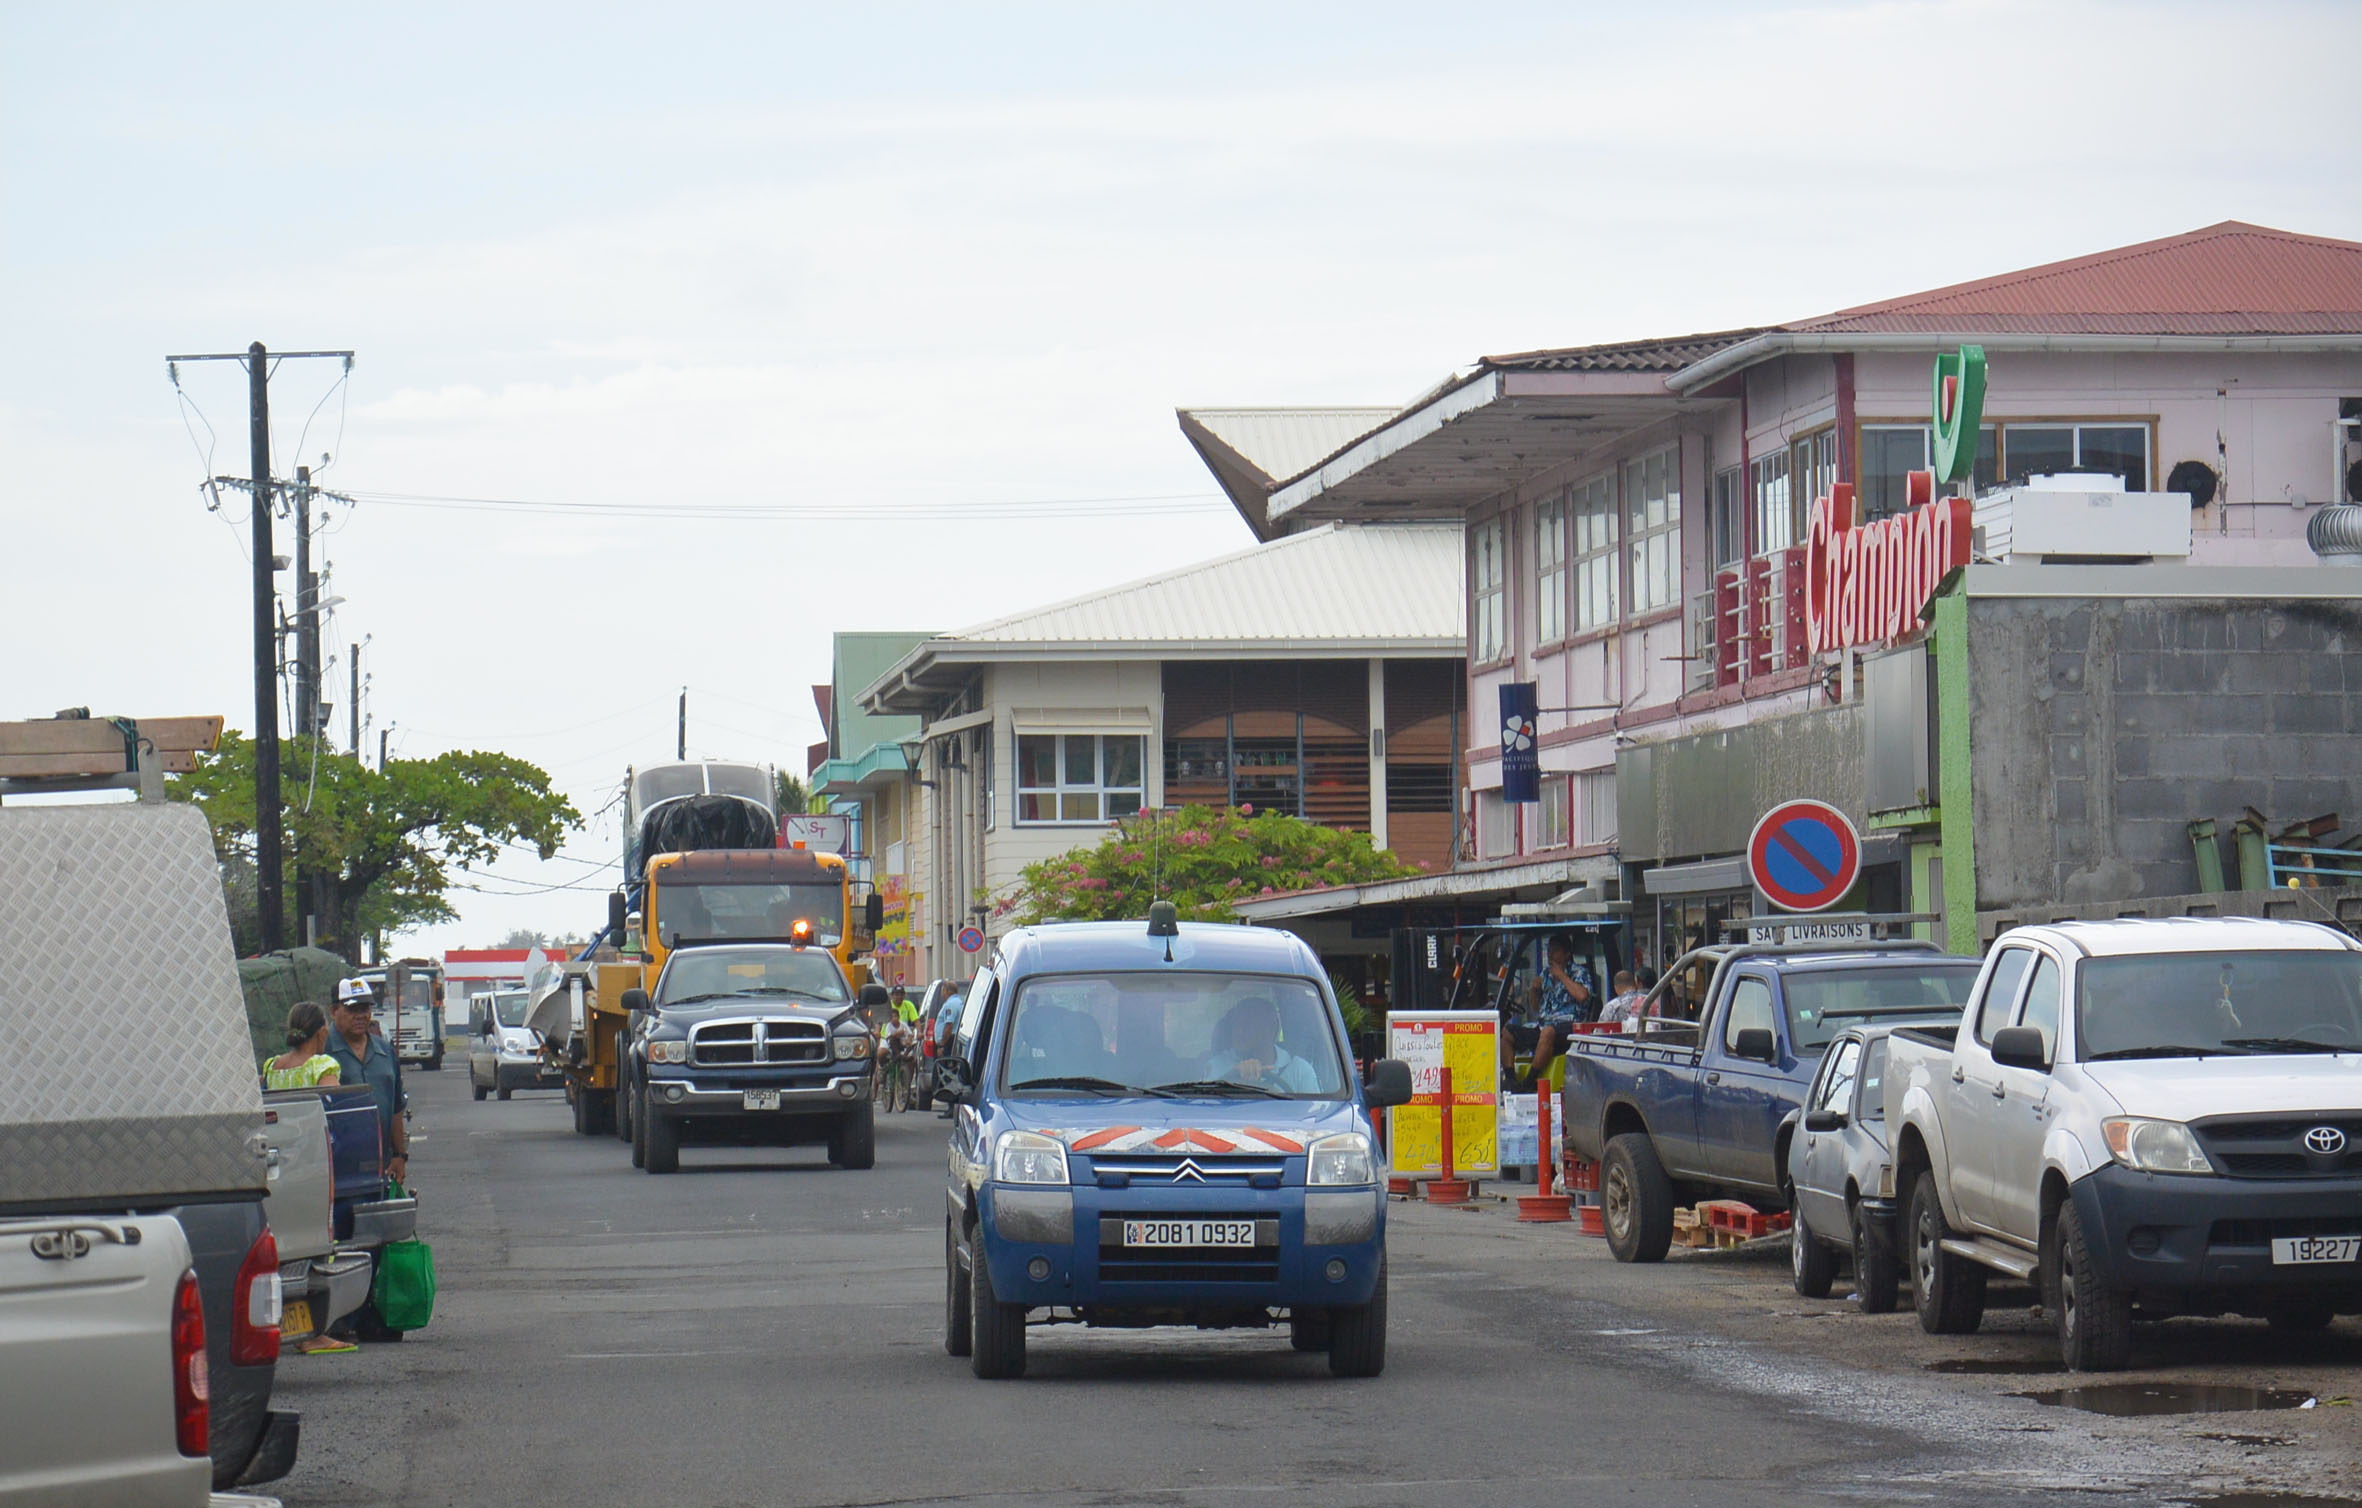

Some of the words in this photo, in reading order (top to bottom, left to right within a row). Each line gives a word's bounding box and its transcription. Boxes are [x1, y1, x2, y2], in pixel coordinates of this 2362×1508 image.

[1806, 472, 1970, 655] Champion
[1792, 923, 1863, 940] LIVRAISONS
[1427, 935, 1438, 969] CLARK
[1454, 1023, 1484, 1033] PROMO
[1454, 1094, 1483, 1104] PROMO
[1145, 1224, 1193, 1243] 2081
[1202, 1223, 1251, 1243] 0932
[2290, 1240, 2361, 1261] 192277
